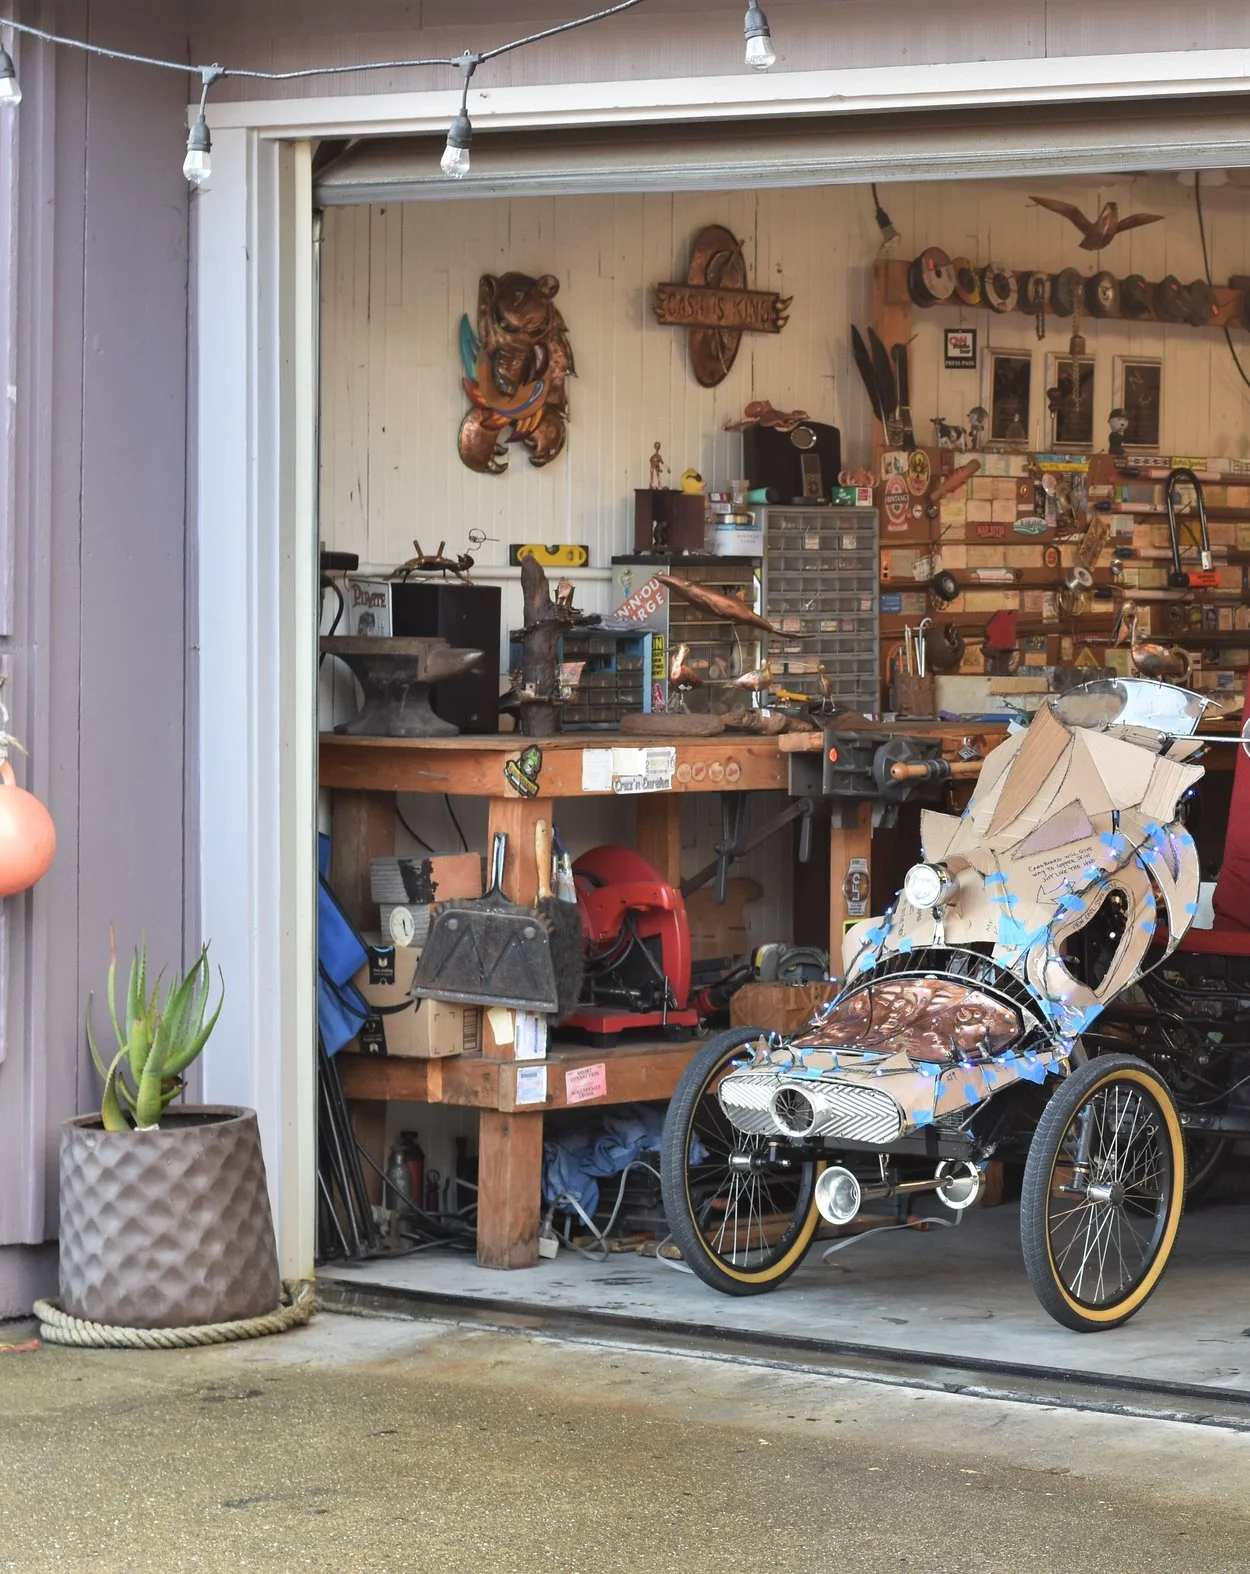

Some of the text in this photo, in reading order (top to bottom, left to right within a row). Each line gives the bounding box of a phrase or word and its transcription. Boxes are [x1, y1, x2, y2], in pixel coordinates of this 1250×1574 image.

[667, 291, 772, 323] CASH IS KING
[351, 583, 387, 608] PIRATE
[615, 778, 642, 792] Cruz'n
